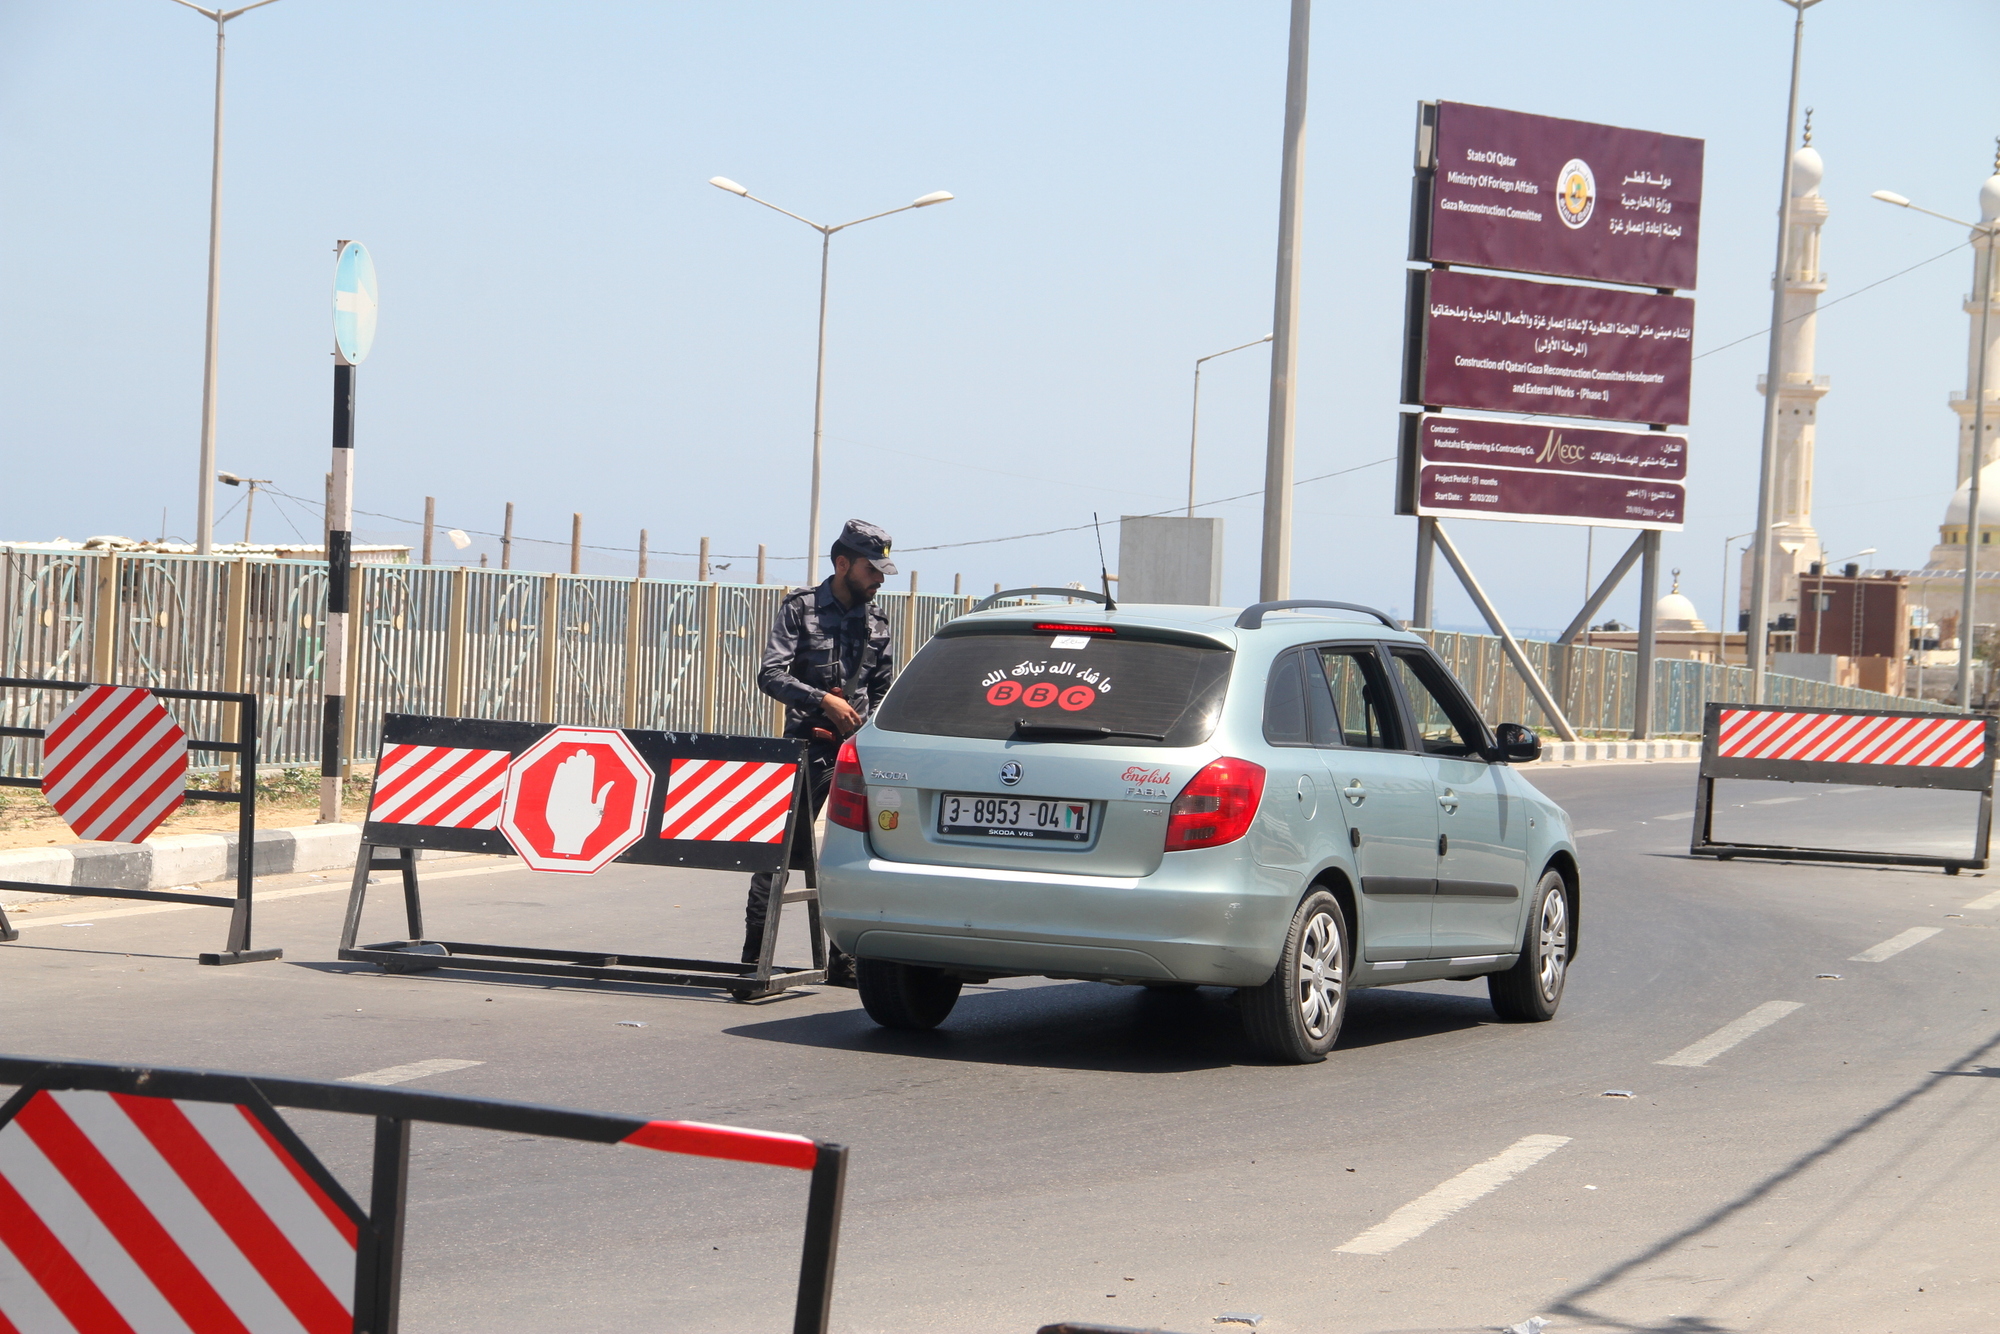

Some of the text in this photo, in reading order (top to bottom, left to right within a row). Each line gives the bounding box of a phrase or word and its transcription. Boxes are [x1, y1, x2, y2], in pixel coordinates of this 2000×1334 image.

[1467, 149, 1517, 167] State Of Qatar
[1478, 175, 1487, 187] Of
[1514, 180, 1539, 195] Affairs
[1622, 170, 1671, 189] دولة قطر
[1441, 198, 1543, 222] Gaza Reconstruction Committee
[1621, 193, 1655, 211] الخارجية
[1609, 218, 1624, 235] غزة
[1469, 306, 1501, 323] الخارجية
[1533, 314, 1547, 330] غزة
[1616, 322, 1640, 338] اللجنة
[1639, 325, 1654, 339] مقر
[1454, 355, 1665, 384] Construction of Qatari Gaza Reconstruction Committee Headquarter
[1512, 383, 1526, 394] and
[1526, 383, 1554, 396] External
[1553, 386, 1575, 398] Works
[1580, 388, 1602, 401] (Phase
[1434, 439, 1535, 456] Mushtaha Engineering & Contracting Co.
[1435, 473, 1453, 484] Project
[1479, 477, 1498, 486] months
[1435, 492, 1448, 501] Start
[982, 661, 1112, 694] ما شاء الله تبارك الله
[1121, 766, 1171, 786] English
[1126, 787, 1168, 798] FABIA
